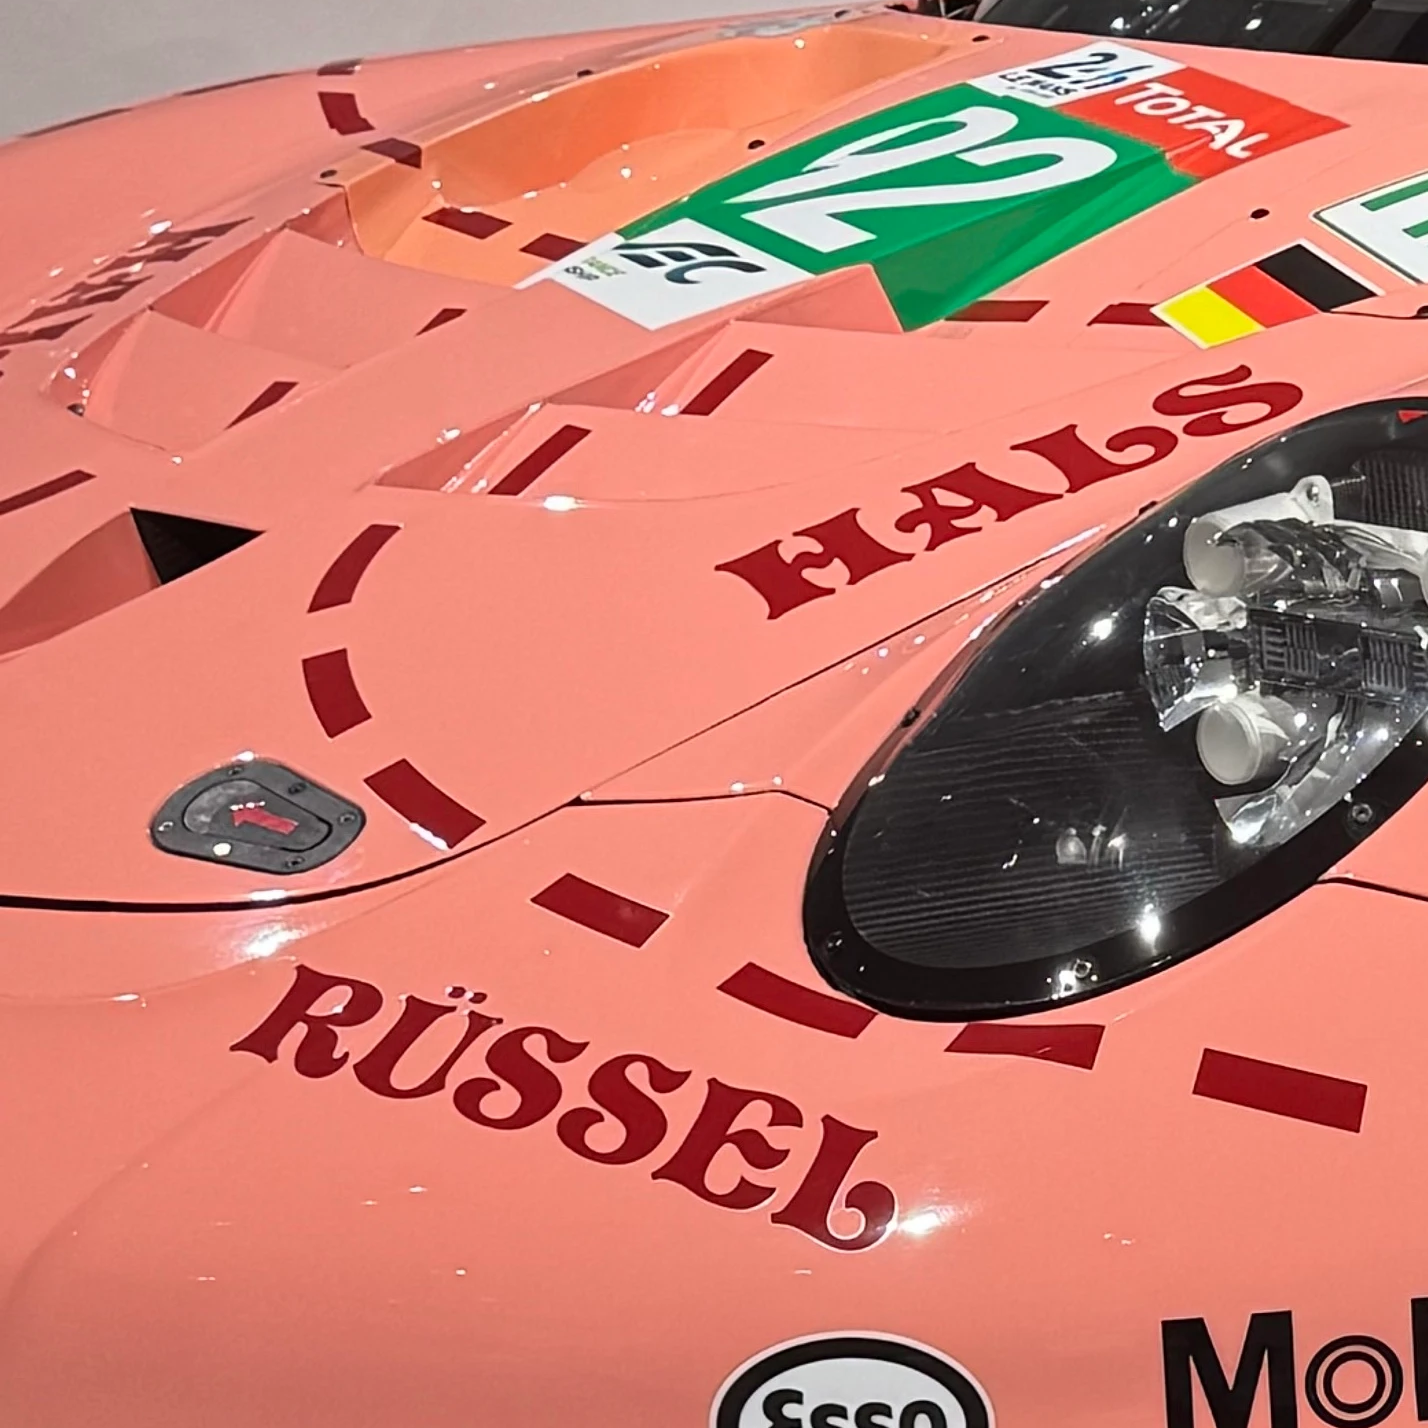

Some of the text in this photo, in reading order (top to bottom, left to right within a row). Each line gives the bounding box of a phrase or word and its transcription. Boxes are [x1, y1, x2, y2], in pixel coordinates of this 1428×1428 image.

[722, 103, 1119, 253] 92
[1113, 81, 1270, 160] TOTAL
[714, 364, 1304, 621] HALS
[229, 962, 897, 1253] RÜSSEL
